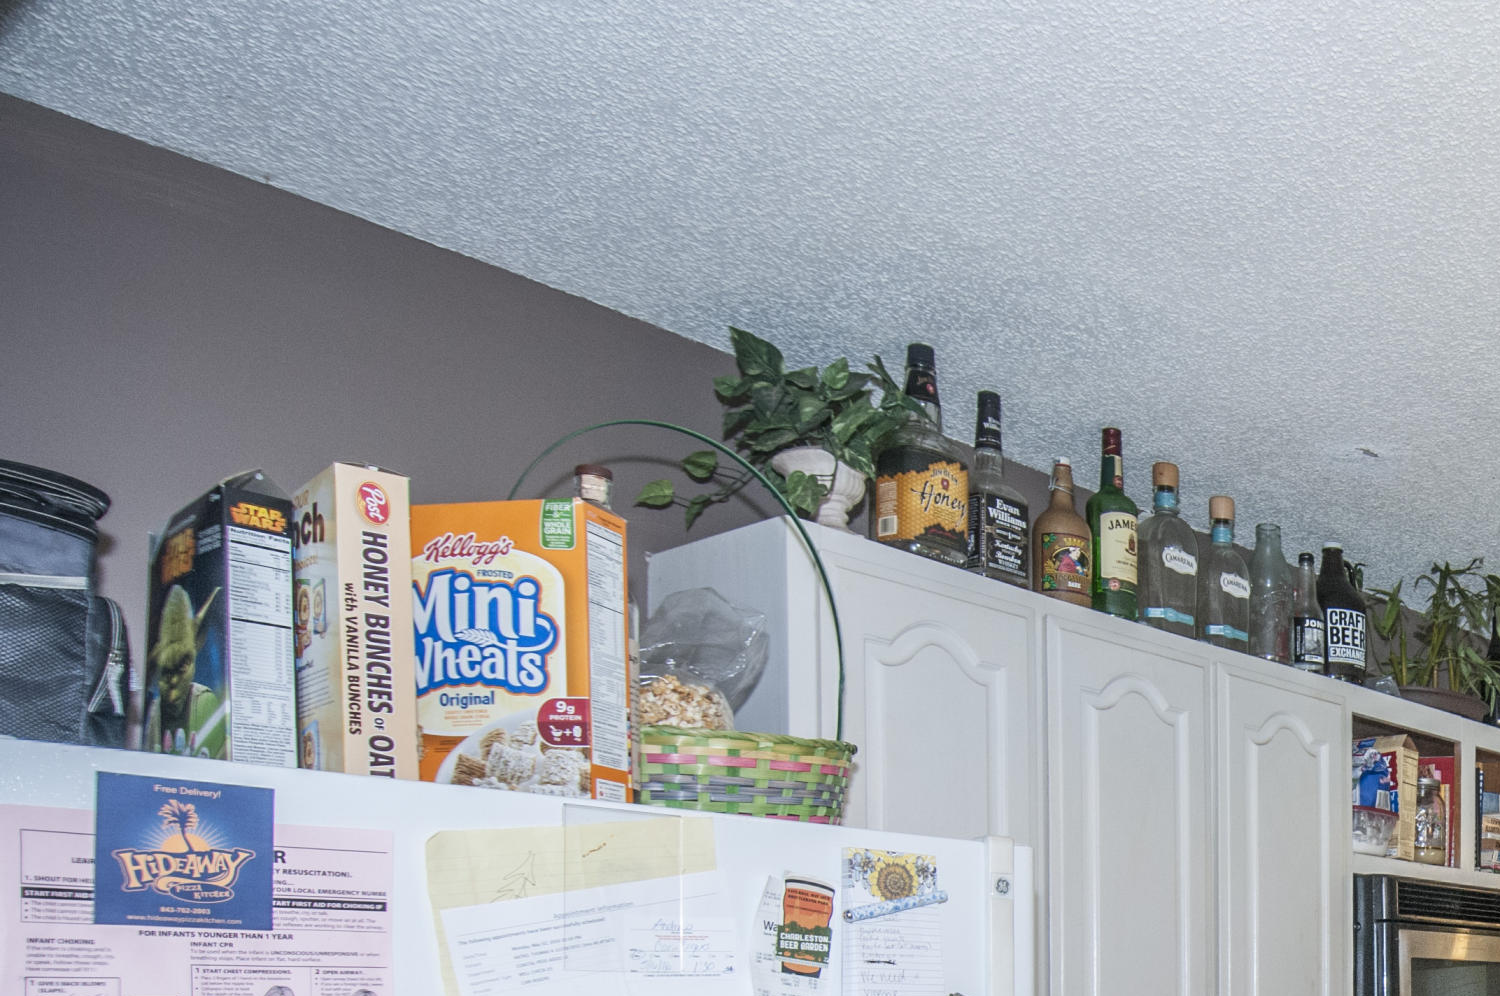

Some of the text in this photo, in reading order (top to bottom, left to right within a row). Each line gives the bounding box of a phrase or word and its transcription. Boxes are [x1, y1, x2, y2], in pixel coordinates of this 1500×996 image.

[229, 502, 283, 519] STAR
[361, 485, 385, 521] Post
[911, 480, 967, 528] Honey
[996, 498, 1020, 516] Evan
[231, 510, 287, 533] WARS
[544, 521, 571, 529] WHOLE
[987, 507, 1027, 529] Williams
[230, 528, 265, 539] Nutrition
[544, 527, 571, 535] GRAIN
[425, 533, 512, 565] Kellogg's
[362, 530, 389, 608] HONEY
[1165, 553, 1194, 569] CAMARENA
[477, 569, 513, 579] FROSTED
[1222, 577, 1248, 592] CAMARENA
[412, 573, 537, 640] Mini
[1329, 610, 1365, 630] CRAFT
[1329, 626, 1365, 649] BEER
[344, 583, 362, 735] with VANILLA BUNCHES
[364, 613, 393, 714] BUNCHES
[440, 691, 495, 709] Original
[555, 701, 575, 715] 9g
[374, 717, 385, 730] OF
[154, 784, 221, 799] Free Delivery!
[282, 869, 352, 878] RESUSCITATION).
[158, 930, 195, 938] INFANTS
[198, 931, 238, 939] YOUNGER
[780, 932, 829, 943] CHARLESTON
[780, 941, 829, 952] BEER GARDEN
